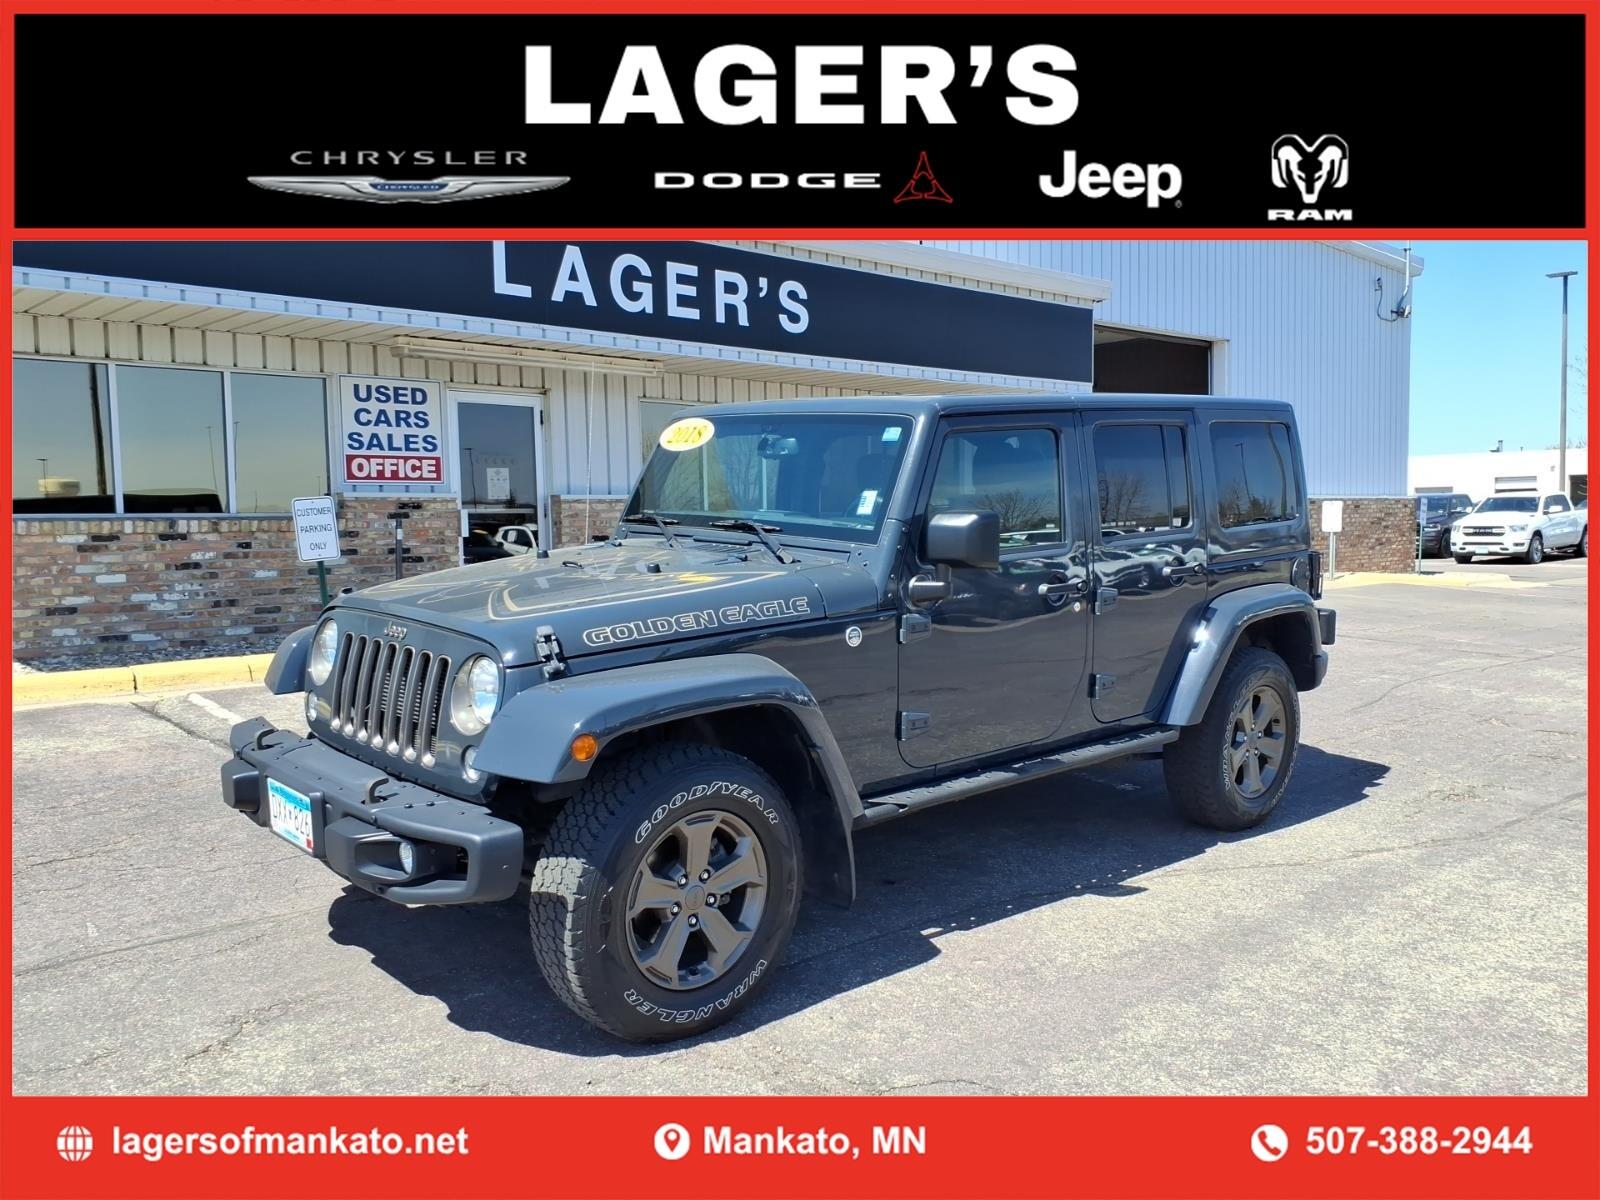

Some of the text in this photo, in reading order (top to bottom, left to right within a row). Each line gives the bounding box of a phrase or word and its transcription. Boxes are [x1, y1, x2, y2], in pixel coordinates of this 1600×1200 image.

[492, 240, 810, 334] LAGER'S
[353, 383, 428, 406] USED
[353, 407, 430, 429] CARS
[347, 431, 438, 453] SALES
[351, 457, 437, 479] OFFICE
[296, 506, 333, 517] CUSTOMER
[300, 523, 333, 533] PARKING
[309, 541, 328, 551] ONLY
[384, 620, 407, 641] Jeep
[582, 596, 811, 647] GOLDEN EAGLE
[635, 780, 780, 845] GOODYEAR
[623, 959, 768, 1023] WRANGLER
